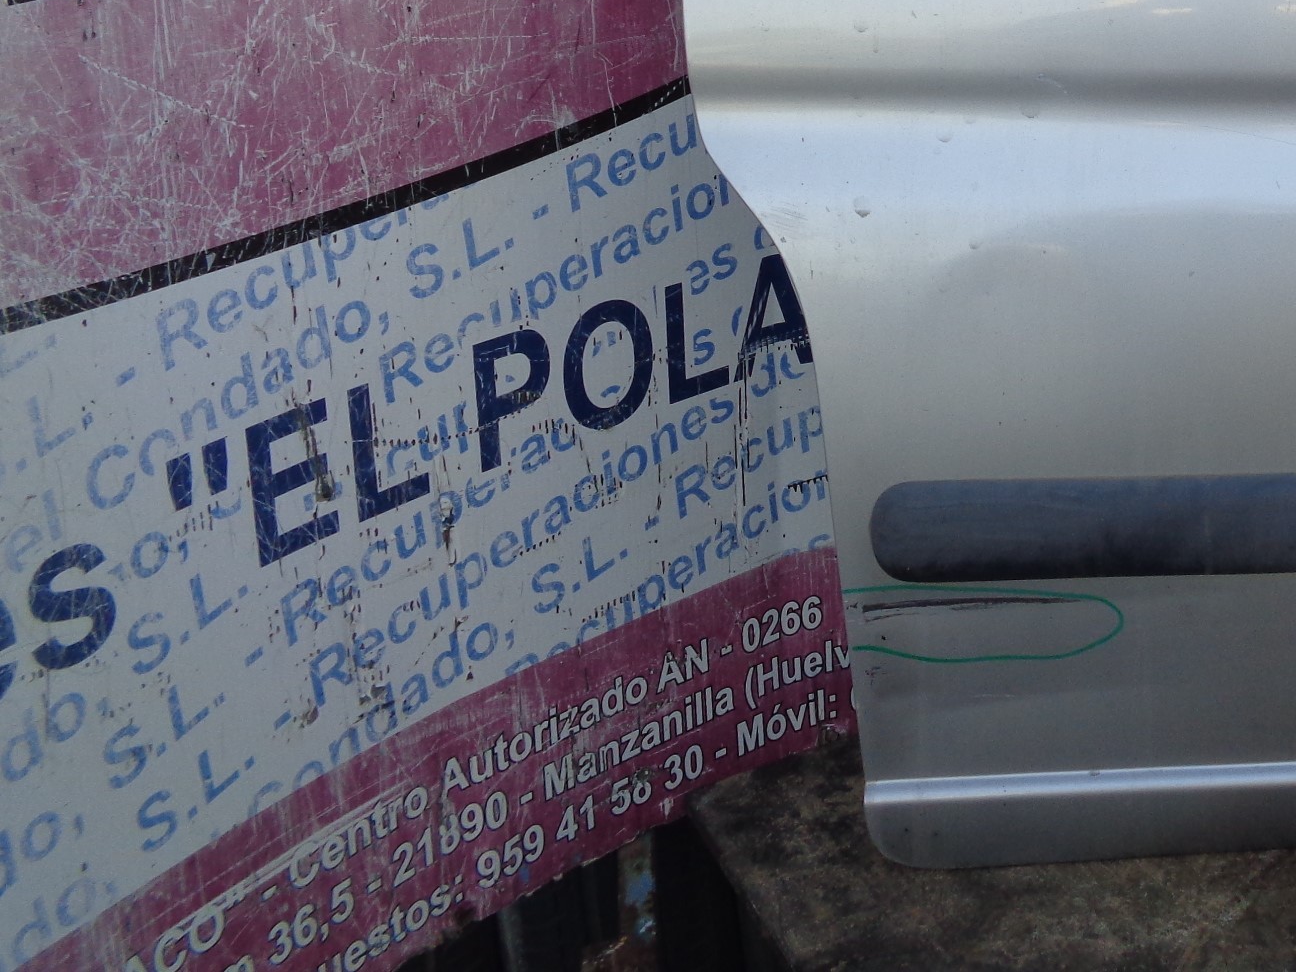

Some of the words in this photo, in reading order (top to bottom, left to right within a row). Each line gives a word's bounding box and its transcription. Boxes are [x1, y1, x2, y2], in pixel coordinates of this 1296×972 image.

[404, 217, 515, 301] S.L.
[164, 382, 432, 570] "EL
[127, 573, 250, 676] S.L.
[531, 536, 630, 616] S.L.
[103, 684, 226, 790] S.L.
[287, 785, 429, 890] Centro
[441, 678, 649, 798] Autorizado
[655, 639, 710, 694] AN
[740, 595, 823, 654] 0266
[475, 824, 545, 889] 959
[555, 794, 596, 843] 41
[663, 744, 704, 792] 30
[736, 687, 838, 760] Móvil:
[136, 749, 256, 853] S.L.
[266, 876, 356, 966] 36,5
[391, 789, 509, 889] 21890
[543, 685, 735, 801] Manzanilla
